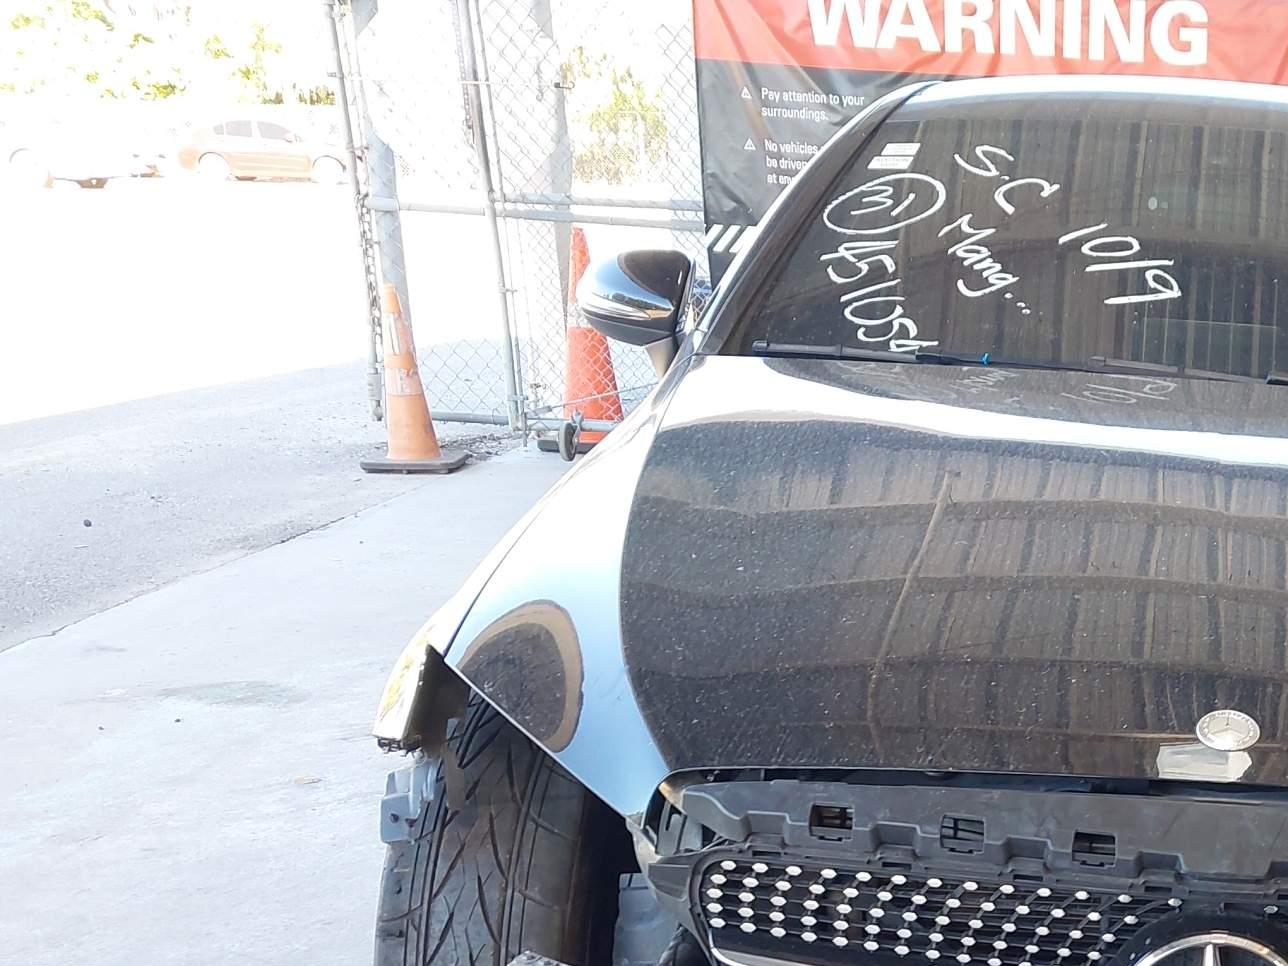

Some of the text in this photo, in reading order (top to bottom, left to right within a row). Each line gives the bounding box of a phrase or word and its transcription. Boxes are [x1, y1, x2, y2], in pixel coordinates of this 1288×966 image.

[808, 0, 1209, 66] WARNING
[761, 87, 865, 107] Pay attention to your
[761, 107, 829, 122] surroundings.
[764, 139, 818, 154] No vehicles
[766, 155, 778, 168] be
[767, 173, 778, 184] at
